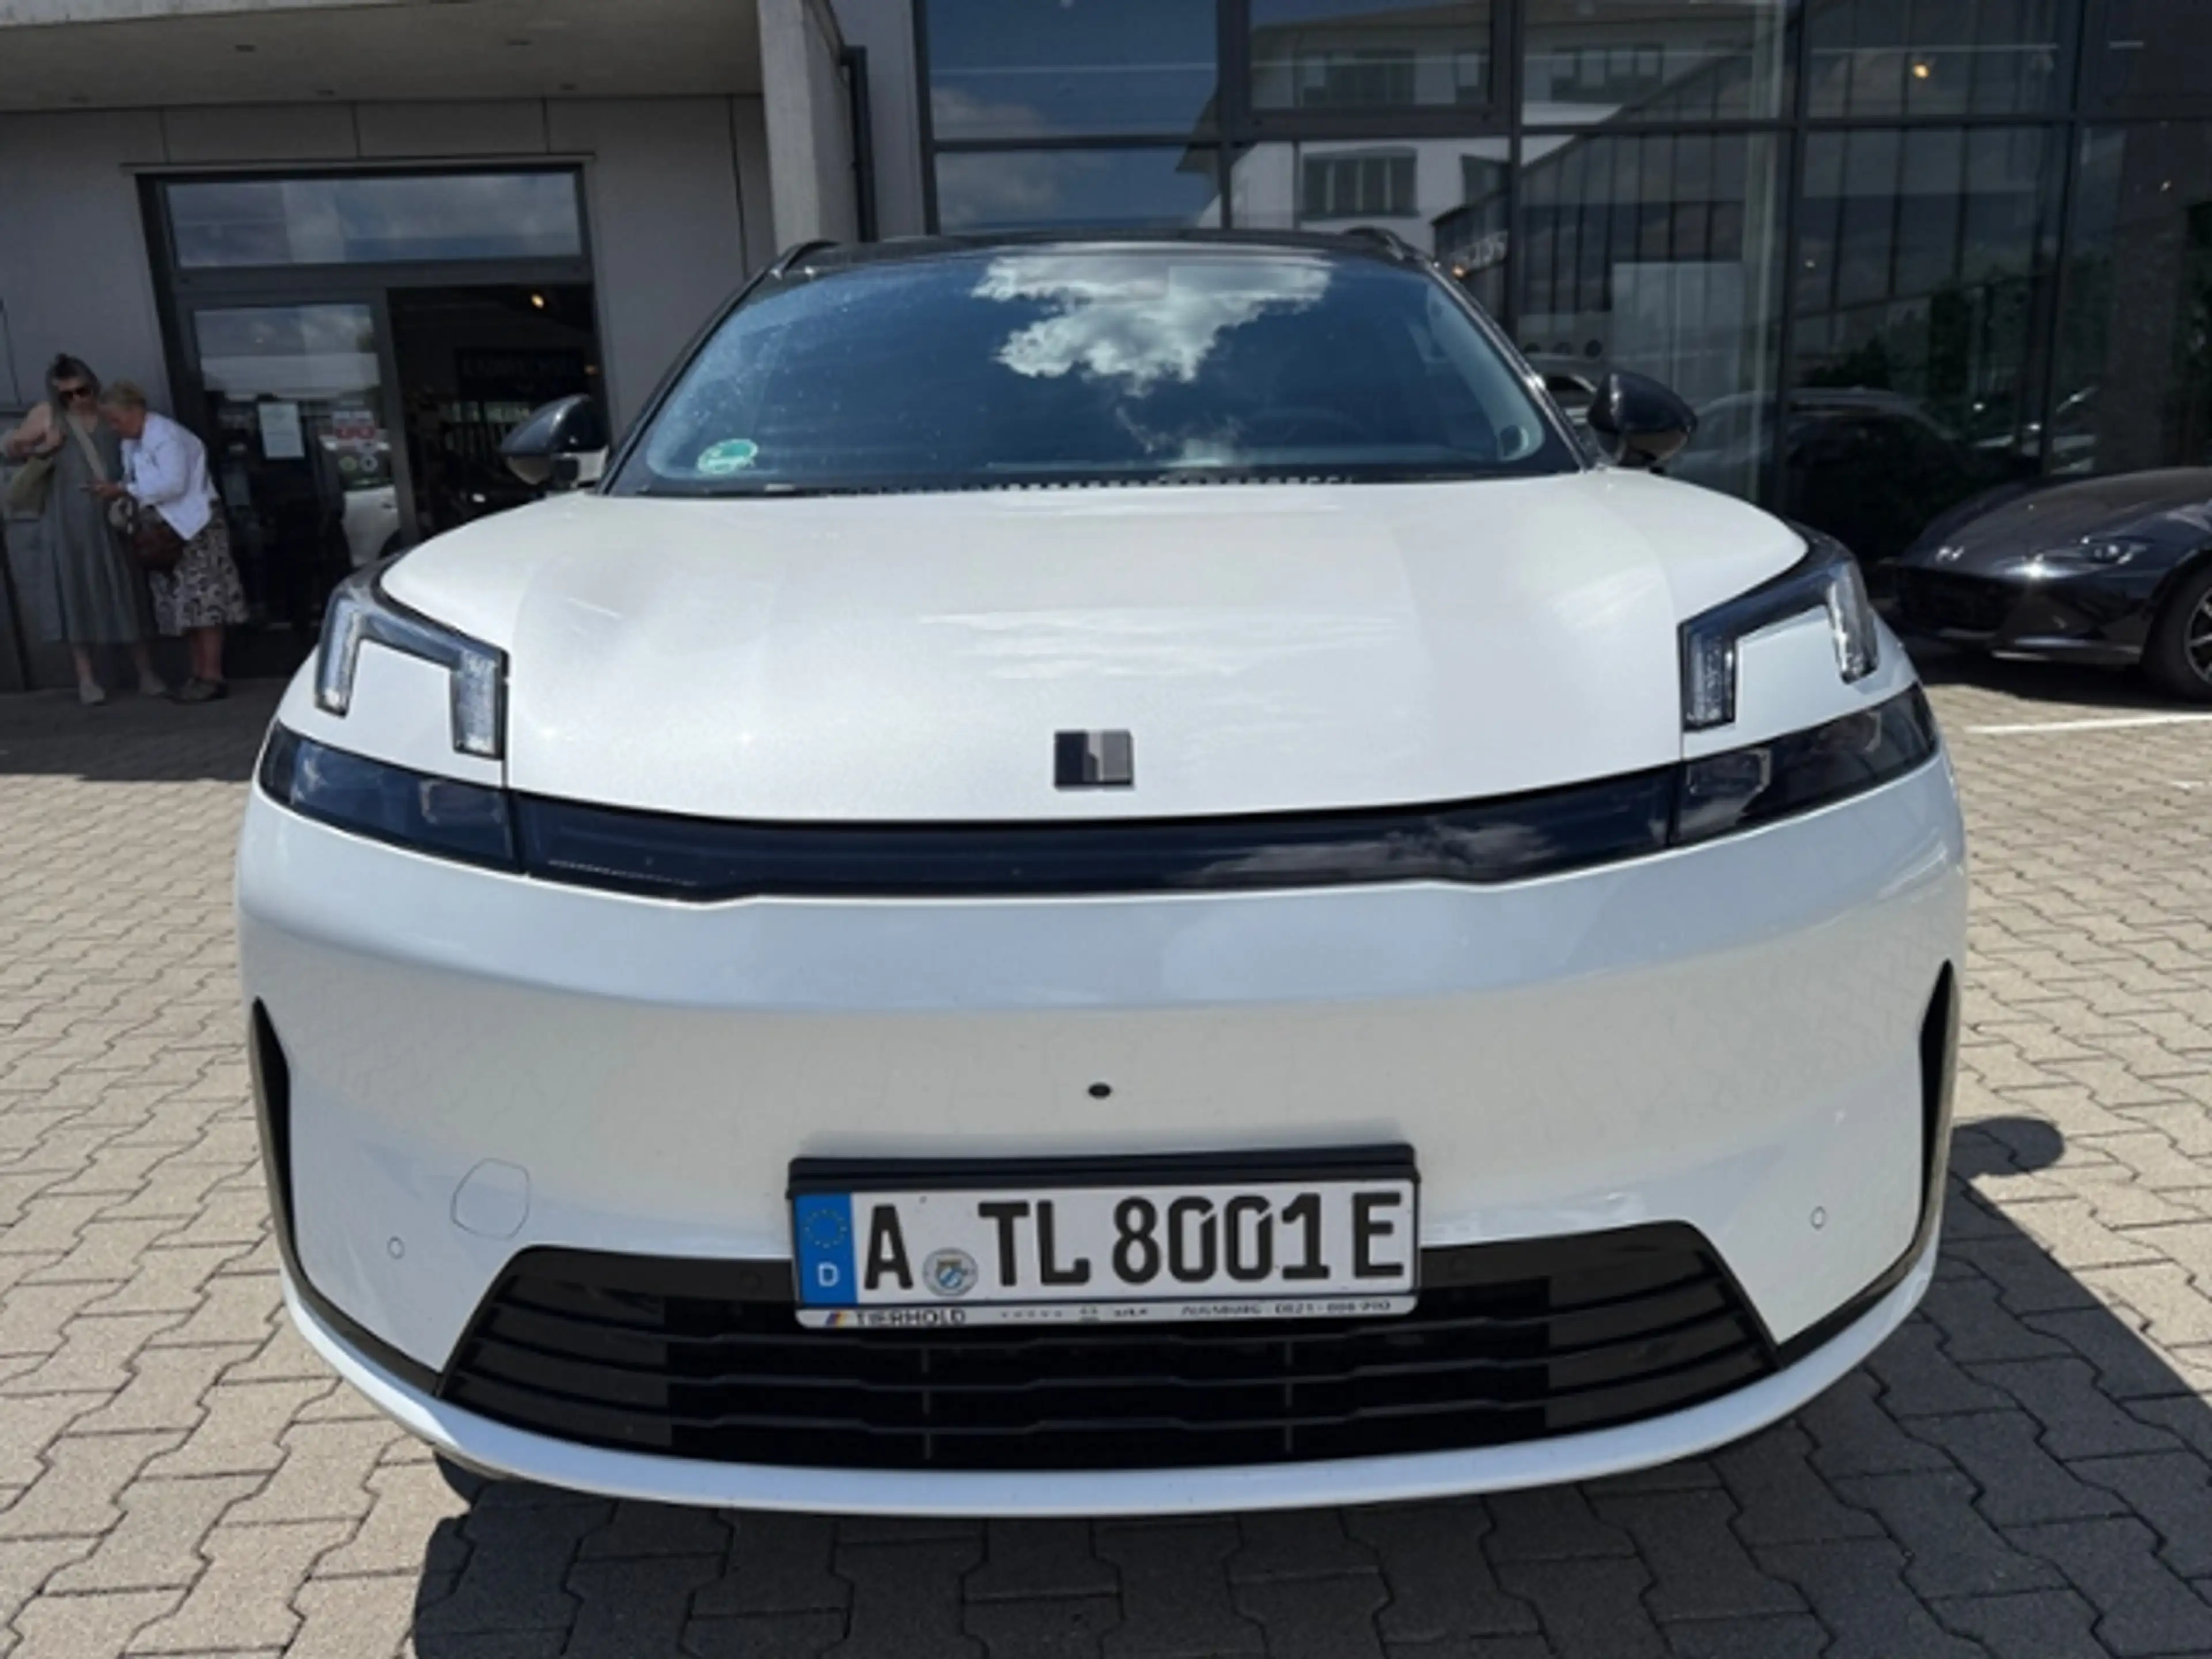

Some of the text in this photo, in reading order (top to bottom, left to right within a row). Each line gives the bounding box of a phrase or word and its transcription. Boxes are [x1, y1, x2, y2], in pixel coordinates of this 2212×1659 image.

[863, 1204, 914, 1290] A
[977, 1199, 1091, 1287] TL
[817, 1262, 840, 1287] D
